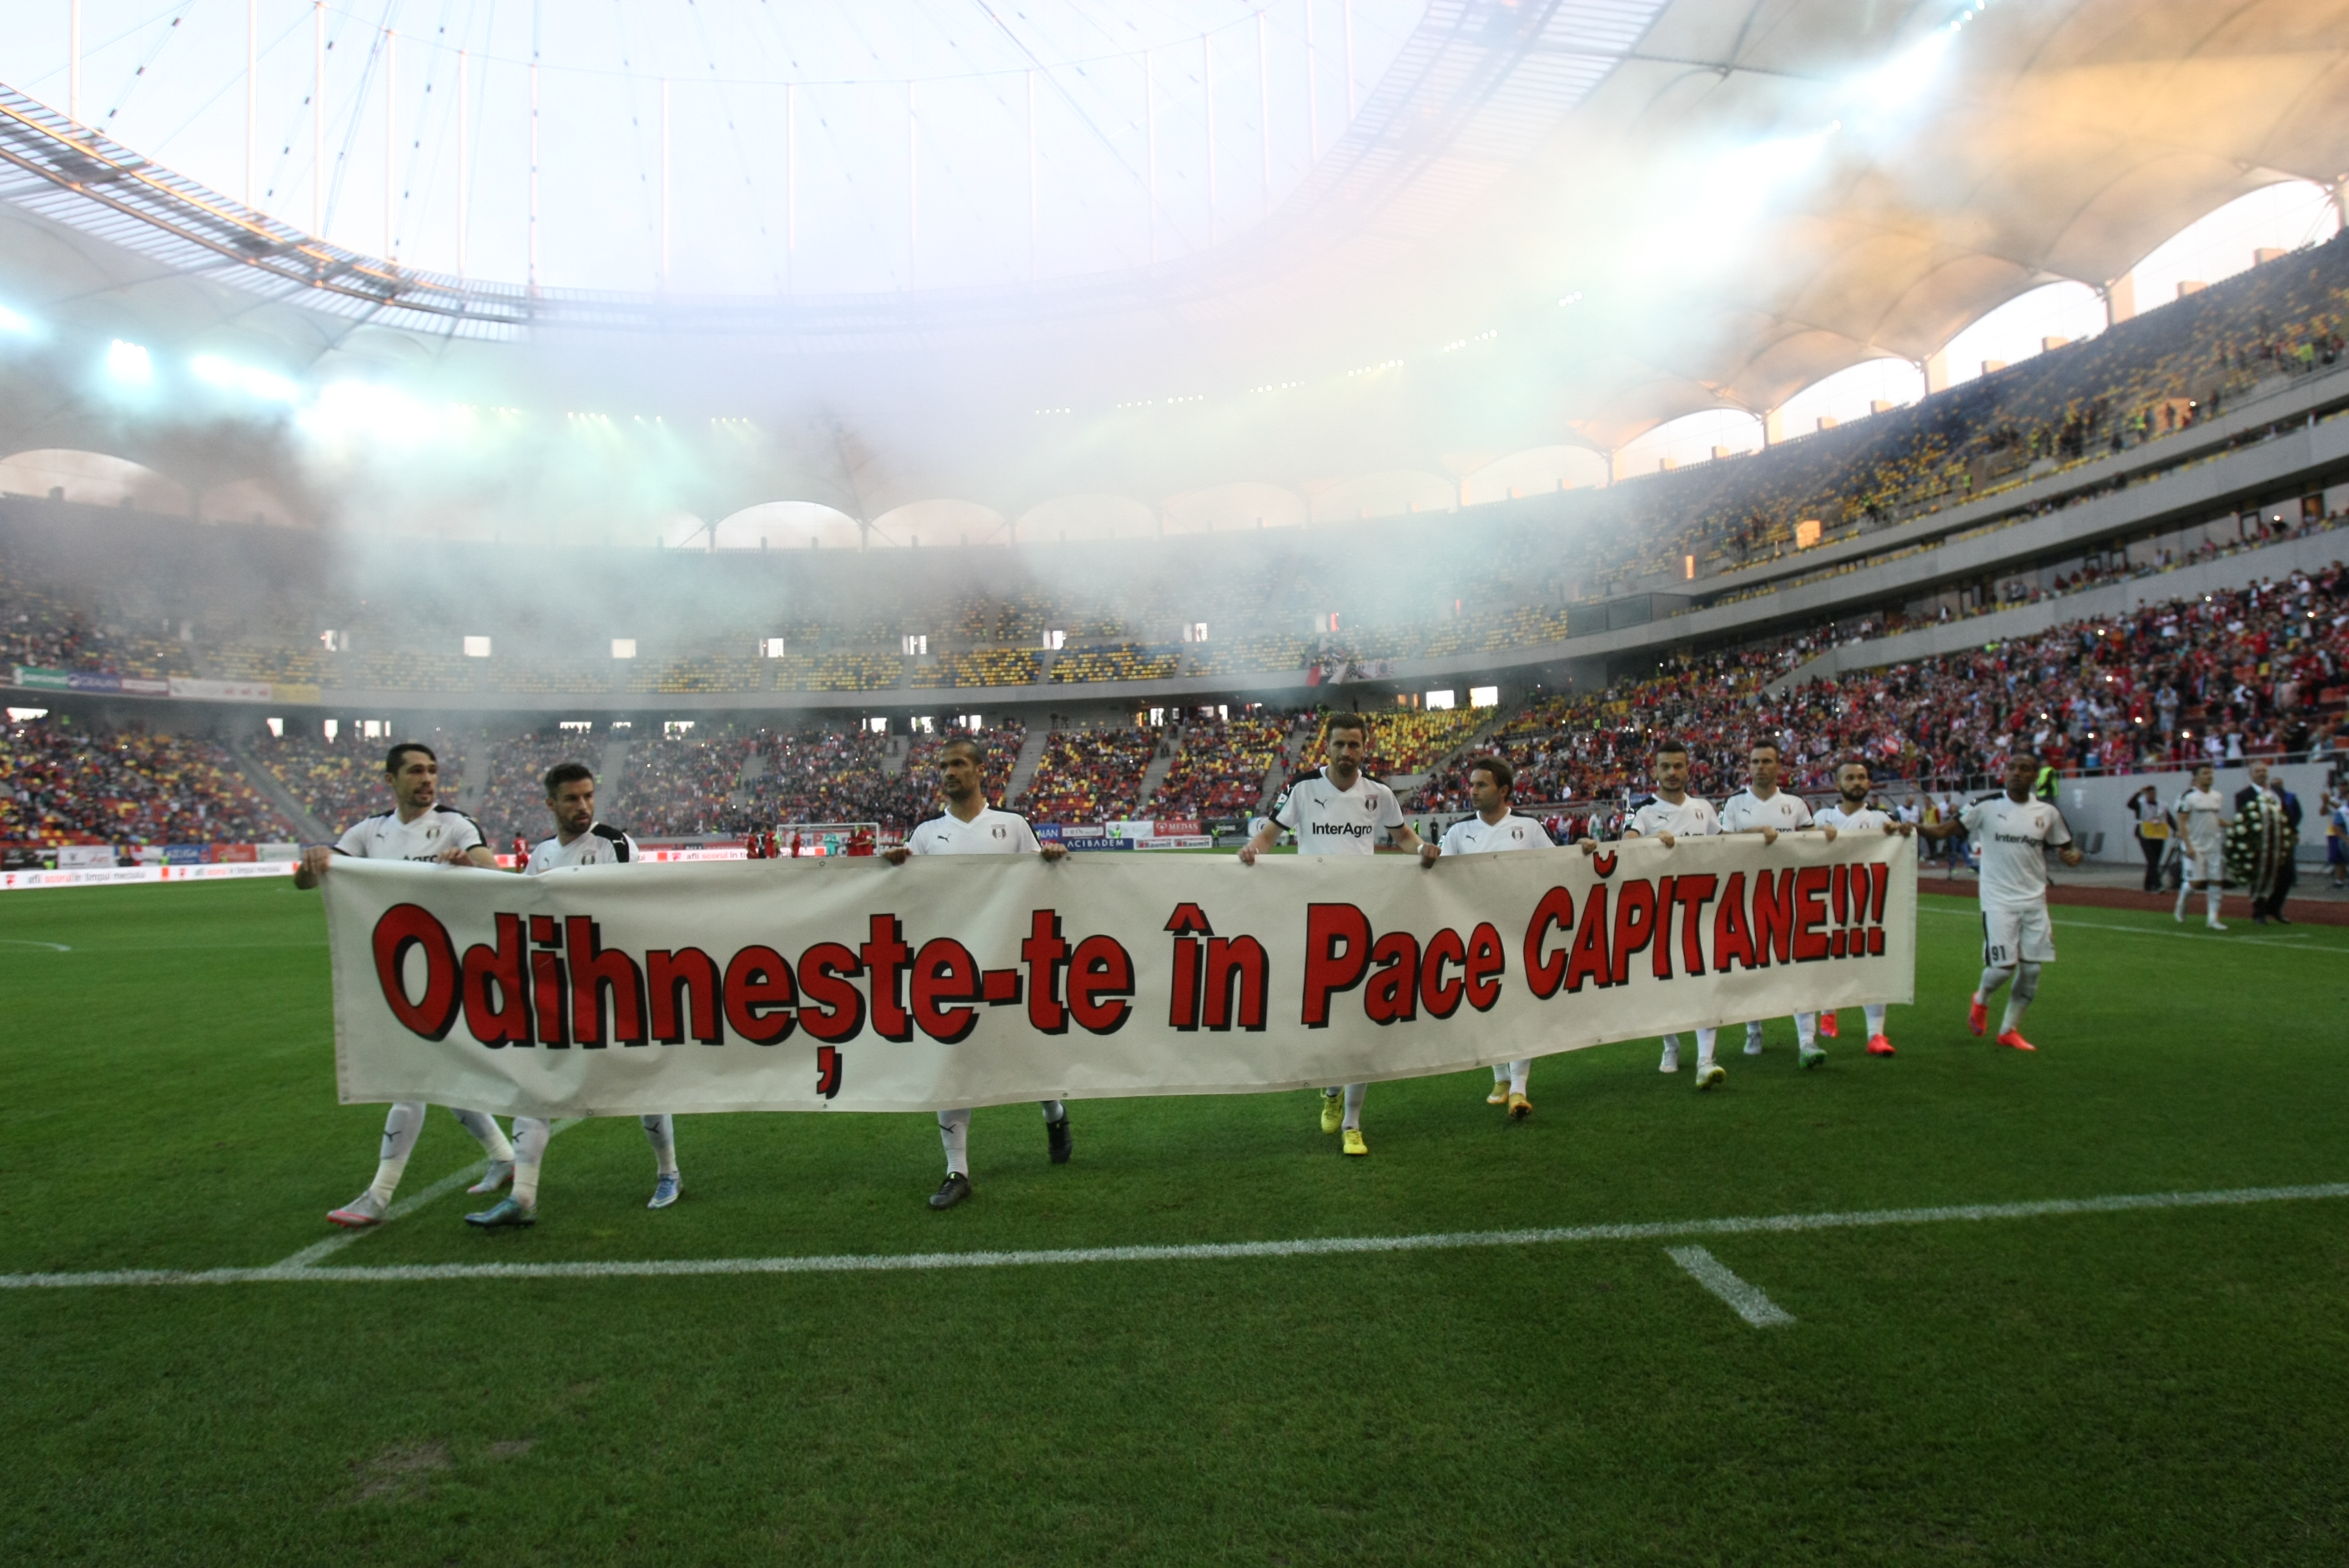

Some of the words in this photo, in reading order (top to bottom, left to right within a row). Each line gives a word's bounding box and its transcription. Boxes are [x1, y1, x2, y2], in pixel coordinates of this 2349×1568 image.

[1169, 822, 1199, 831] MEDAS
[1312, 822, 1372, 838] InterAgro
[1067, 840, 1124, 848] ACIBADEM
[1164, 902, 1269, 1032] în
[1300, 902, 1505, 1028] Pace
[1523, 849, 1889, 1000] CĂPITANE!!!
[1991, 945, 2006, 962] 91
